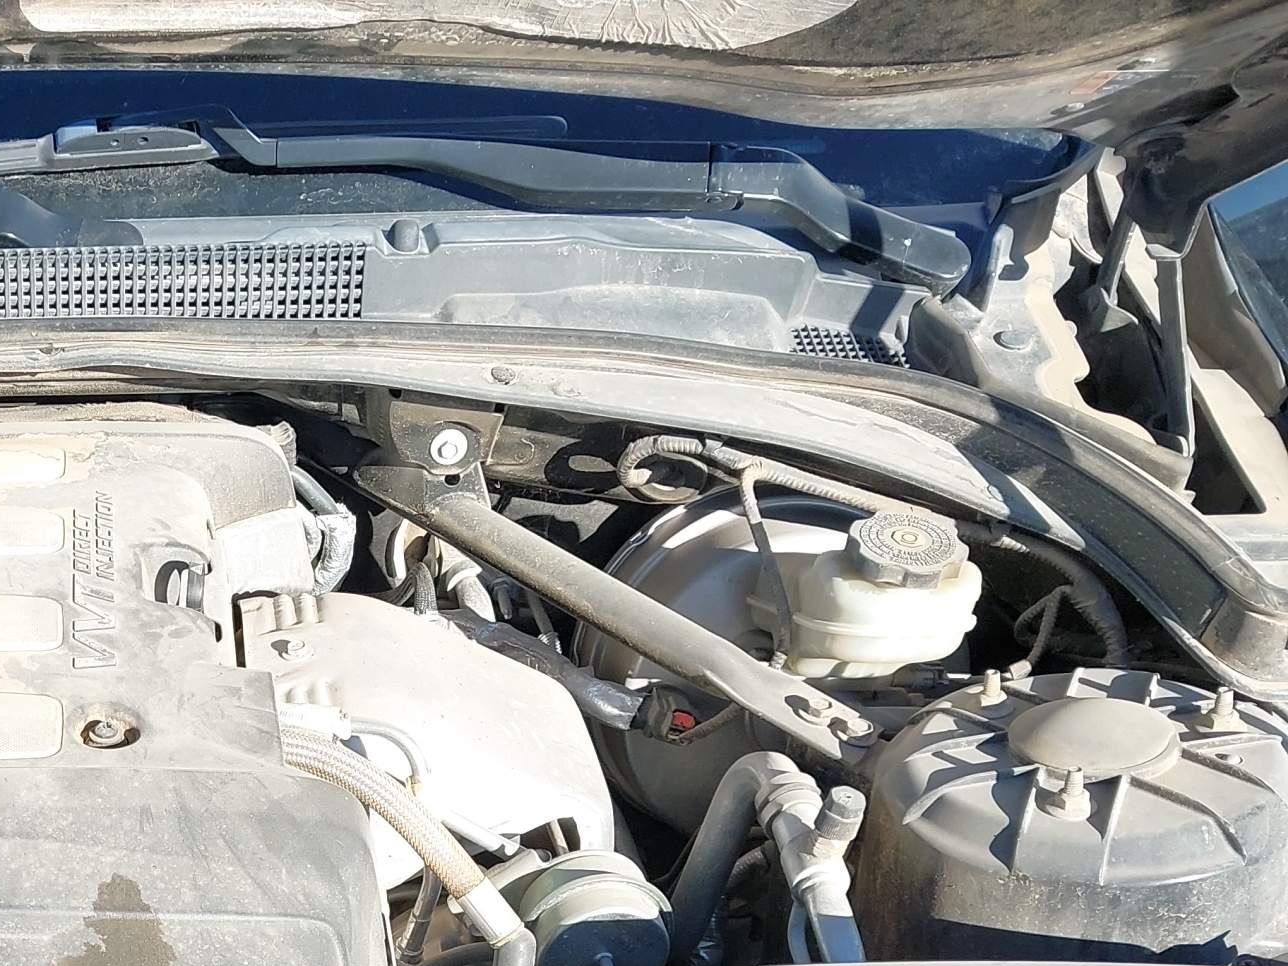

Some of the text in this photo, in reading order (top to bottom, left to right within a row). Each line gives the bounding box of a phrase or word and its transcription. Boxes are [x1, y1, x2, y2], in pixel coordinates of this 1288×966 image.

[72, 508, 91, 575] DIRECT
[95, 490, 115, 582] INJECTION
[71, 574, 117, 670] VVT
